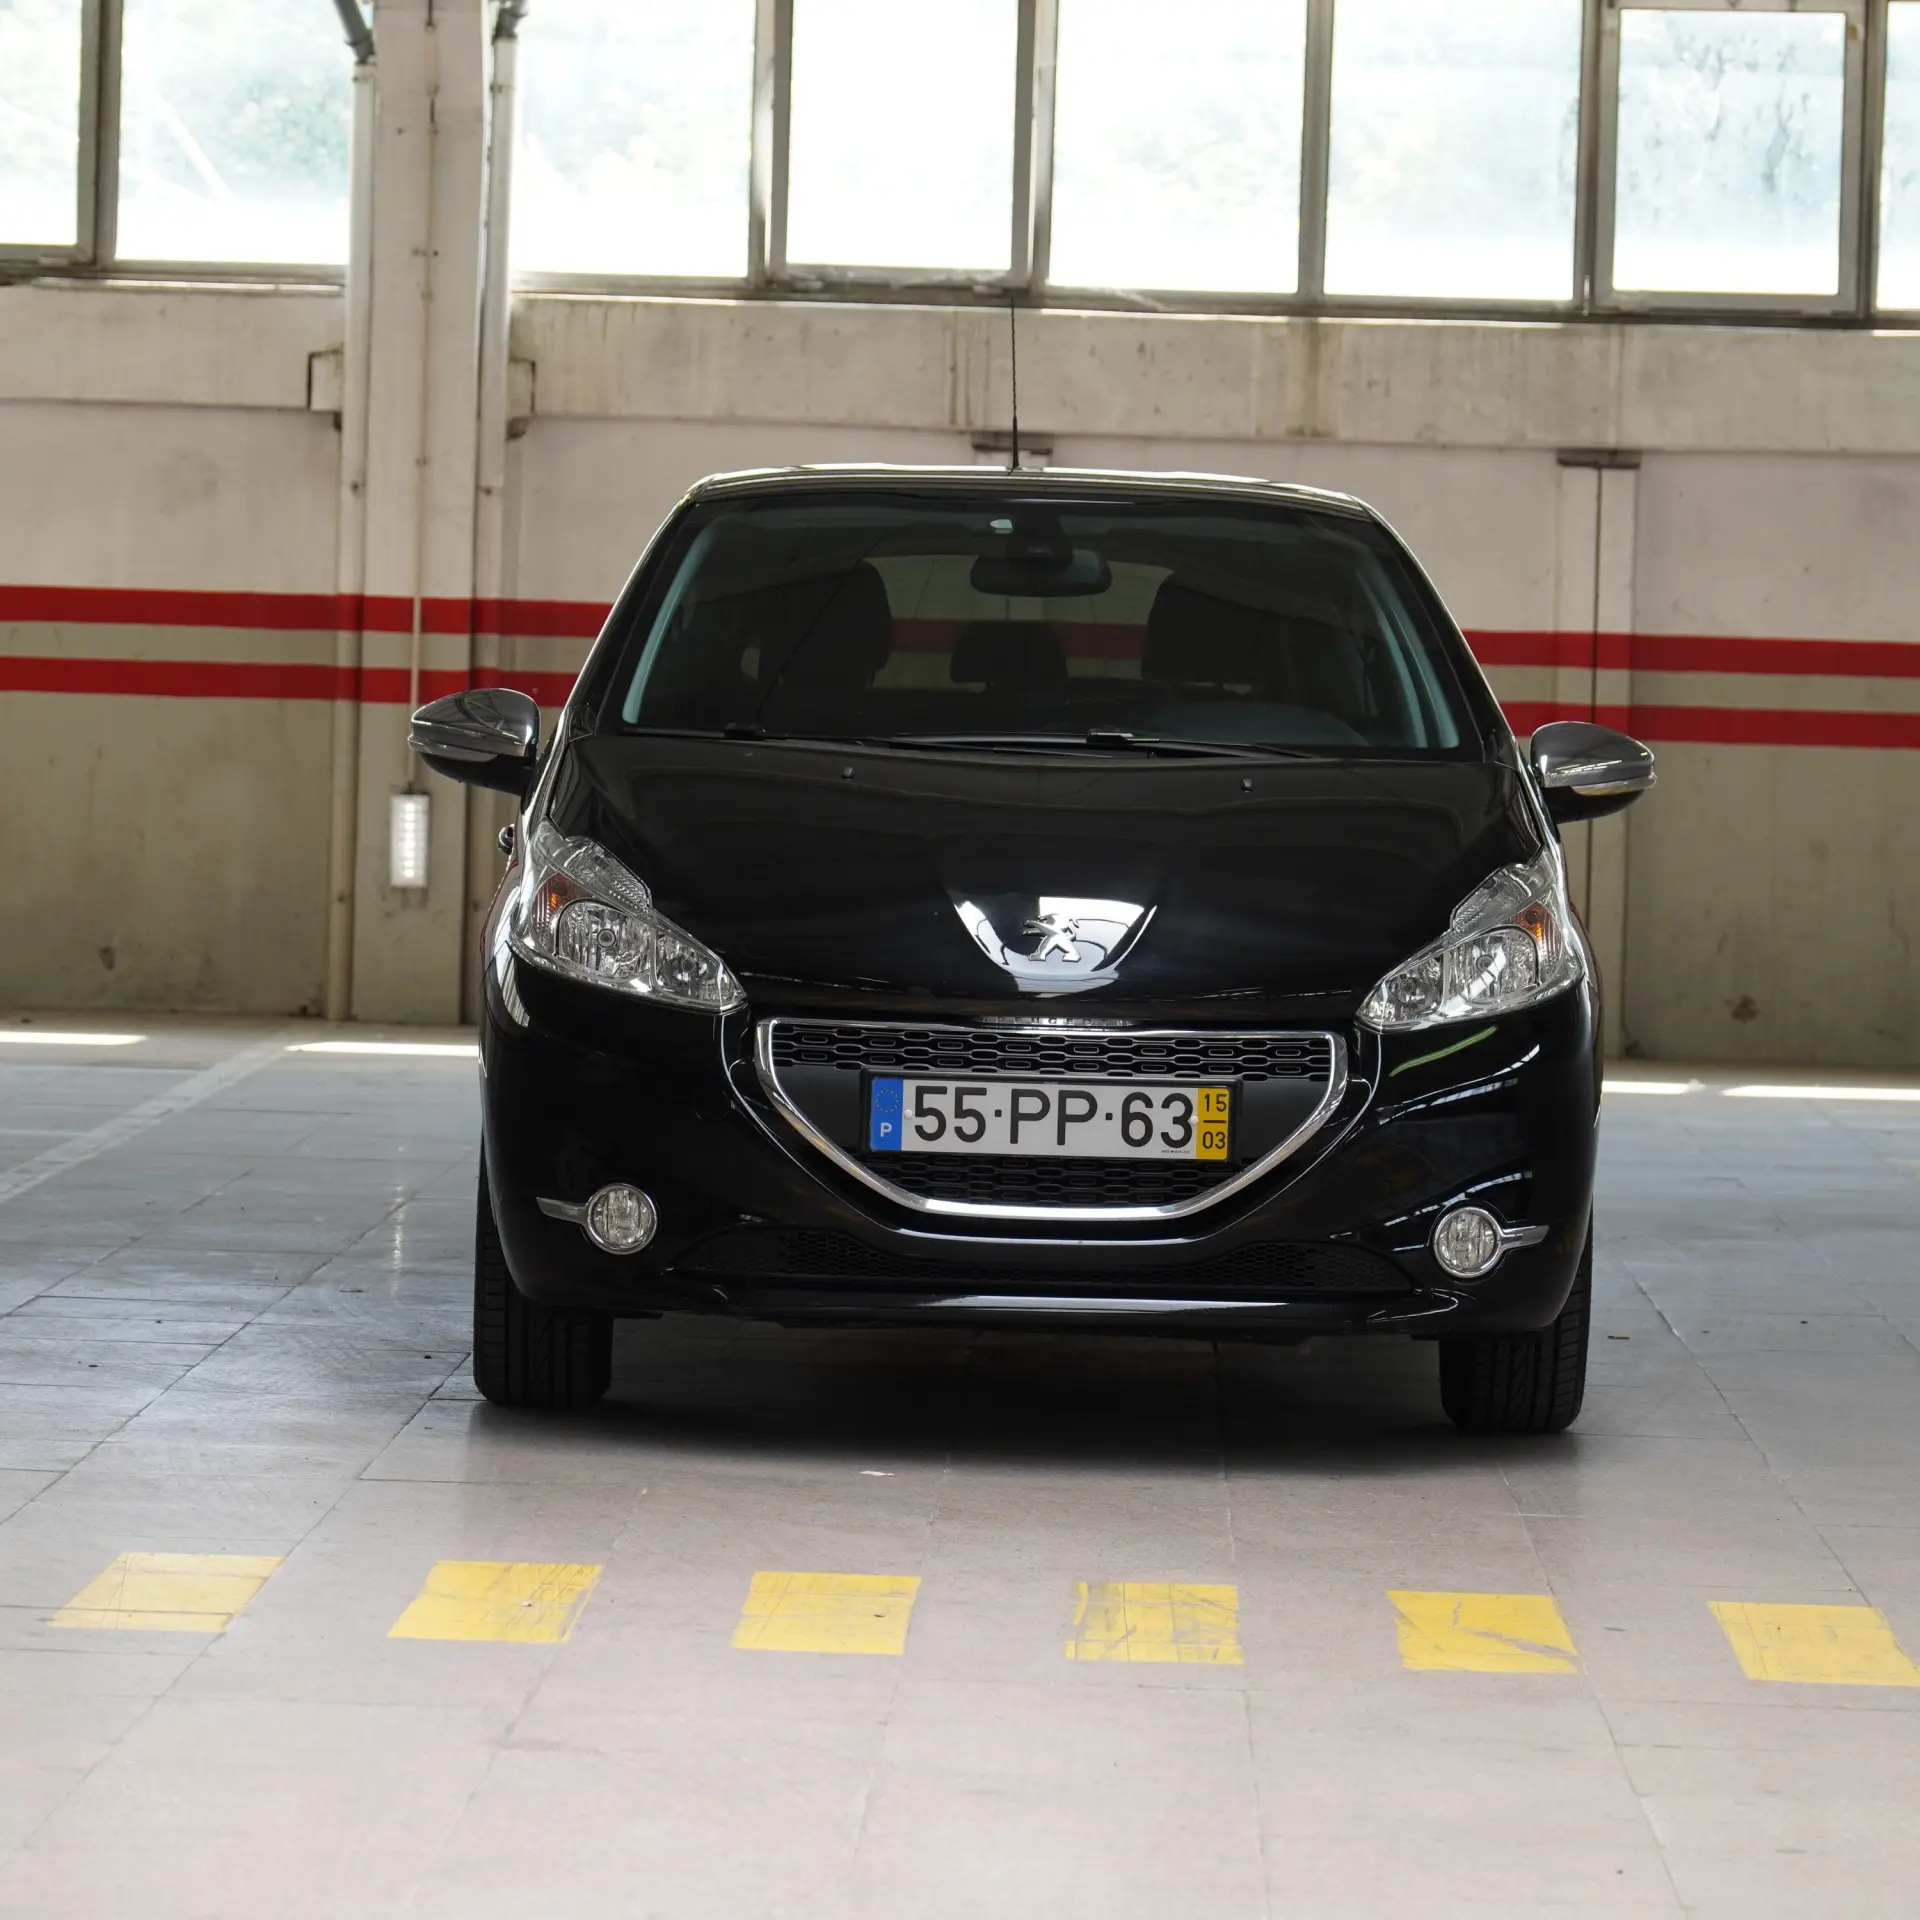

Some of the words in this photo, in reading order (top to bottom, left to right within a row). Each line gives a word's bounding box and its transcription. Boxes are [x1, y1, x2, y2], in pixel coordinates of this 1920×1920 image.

[1203, 1093, 1228, 1112] 15
[880, 1121, 893, 1138] P
[1202, 1131, 1226, 1150] 03
